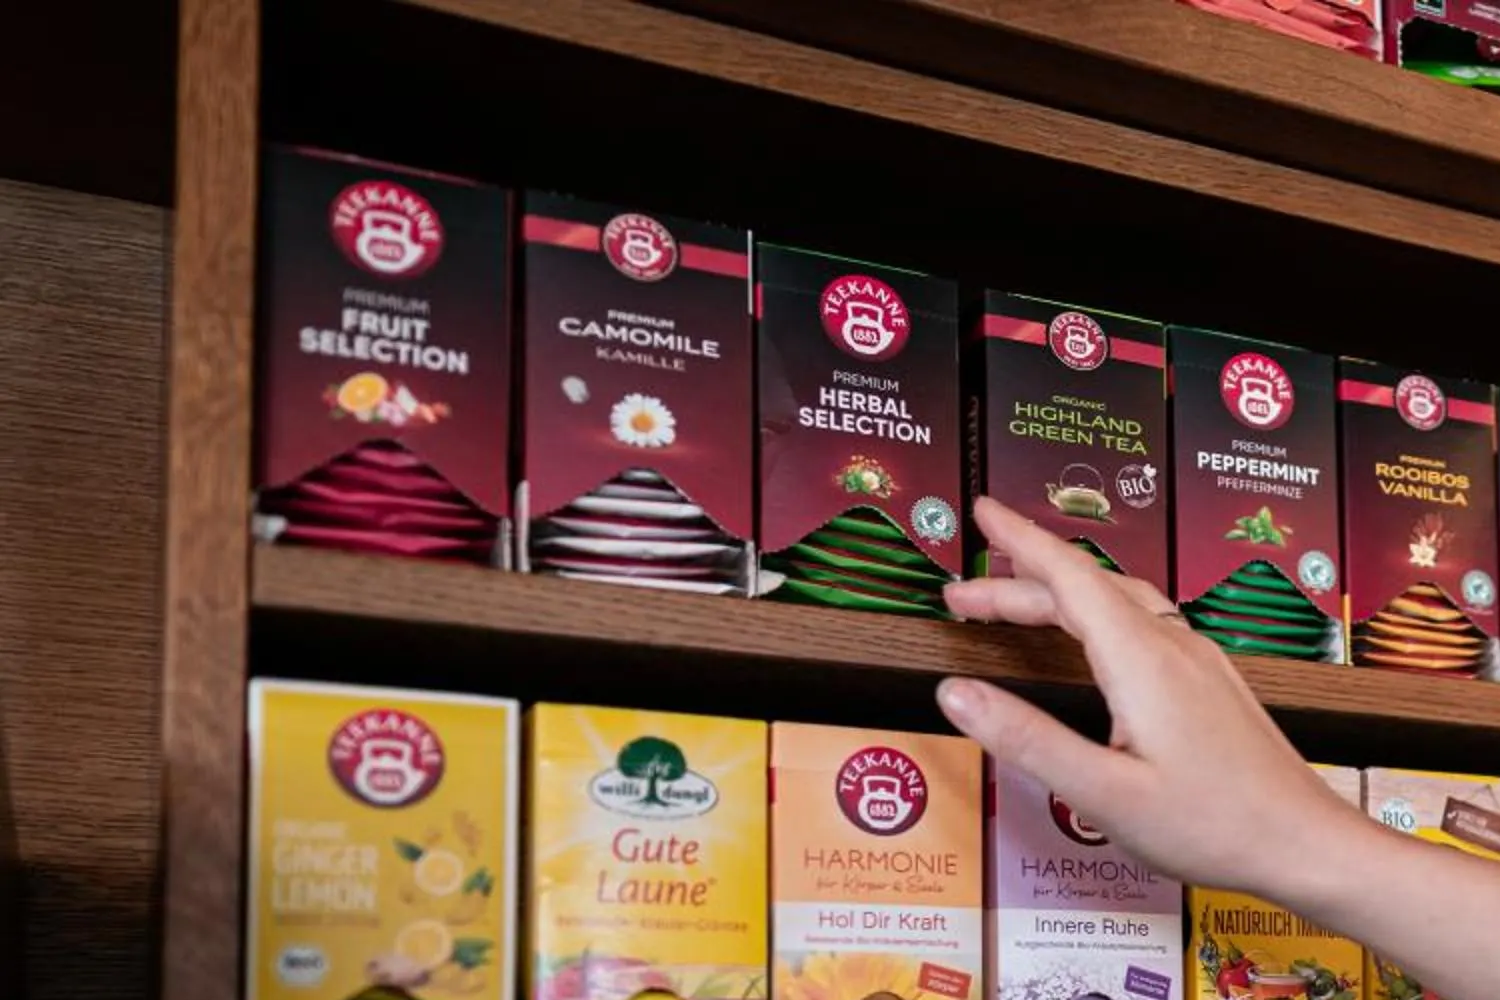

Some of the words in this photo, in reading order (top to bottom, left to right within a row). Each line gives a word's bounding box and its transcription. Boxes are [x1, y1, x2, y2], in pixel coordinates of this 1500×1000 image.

[607, 309, 675, 329] PREMIUM
[823, 280, 906, 328] TEEKANNE
[342, 308, 431, 342] FRUIT
[558, 316, 721, 359] CAMOMILE
[299, 326, 469, 375] SELECTION
[595, 346, 687, 372] KAMILLE
[832, 369, 899, 393] PREMIUM
[1223, 358, 1292, 401] TEEKANNE
[819, 386, 913, 420] HERBAL
[799, 406, 931, 445] SELECTION
[1015, 402, 1142, 436] HIGHLAND
[1009, 420, 1093, 446] GREEN
[1101, 434, 1148, 456] TEA
[1231, 439, 1287, 459] PREMIUM
[1197, 451, 1321, 485] PEPPERMINT
[1375, 462, 1470, 489] ROOIBOS
[1118, 474, 1154, 498] BIO
[1217, 475, 1304, 500] PFEFFERMINZE
[1378, 479, 1468, 507] VANILLA
[839, 752, 925, 798] TEEKANNE
[1382, 809, 1415, 830] BIO
[612, 827, 700, 866] Gute
[803, 848, 958, 876] HARMONIE
[818, 911, 853, 929] Hol
[863, 911, 891, 929] Dir
[899, 912, 948, 931] Kraft
[1035, 916, 1097, 934] Innere
[1103, 917, 1149, 937] Ruhe
[1213, 906, 1292, 937] NATÜRLICH
